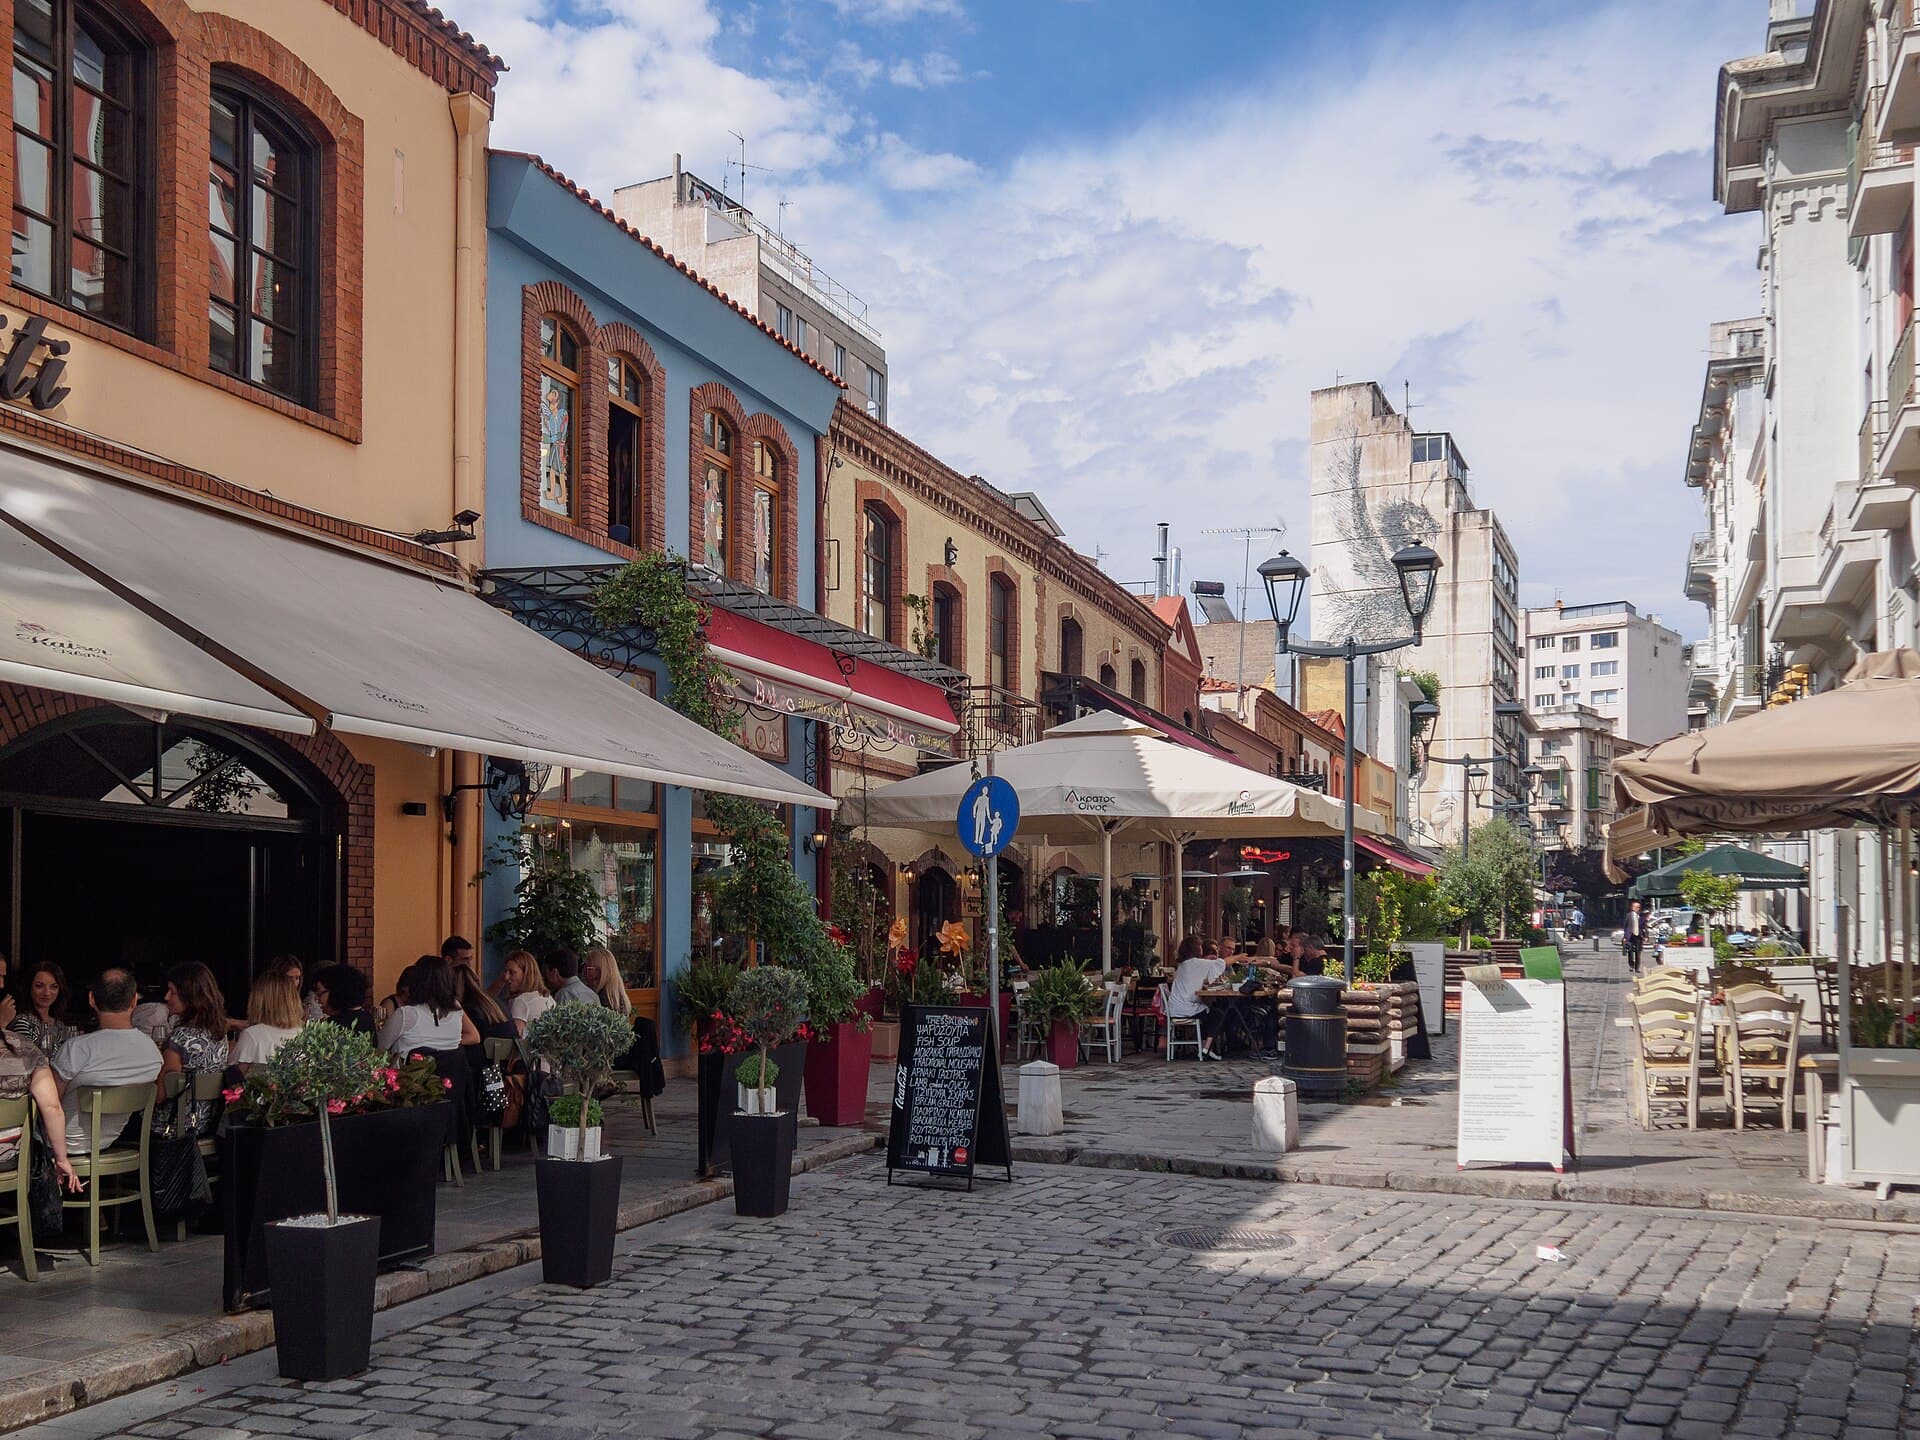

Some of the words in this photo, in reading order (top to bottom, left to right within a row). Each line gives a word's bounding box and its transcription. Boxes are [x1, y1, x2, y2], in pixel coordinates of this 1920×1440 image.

[1228, 801, 1255, 816] Mythos
[916, 1024, 969, 1037] ΨΑΡΟΣΟΥΠΑ
[916, 1037, 935, 1046] FISH
[937, 1037, 960, 1047] SOUP
[909, 1078, 928, 1088] LAMB
[948, 1080, 970, 1090] OVEN
[948, 1119, 973, 1131] KEBAB
[910, 1135, 924, 1145] RED
[949, 1137, 971, 1148] FRIED
